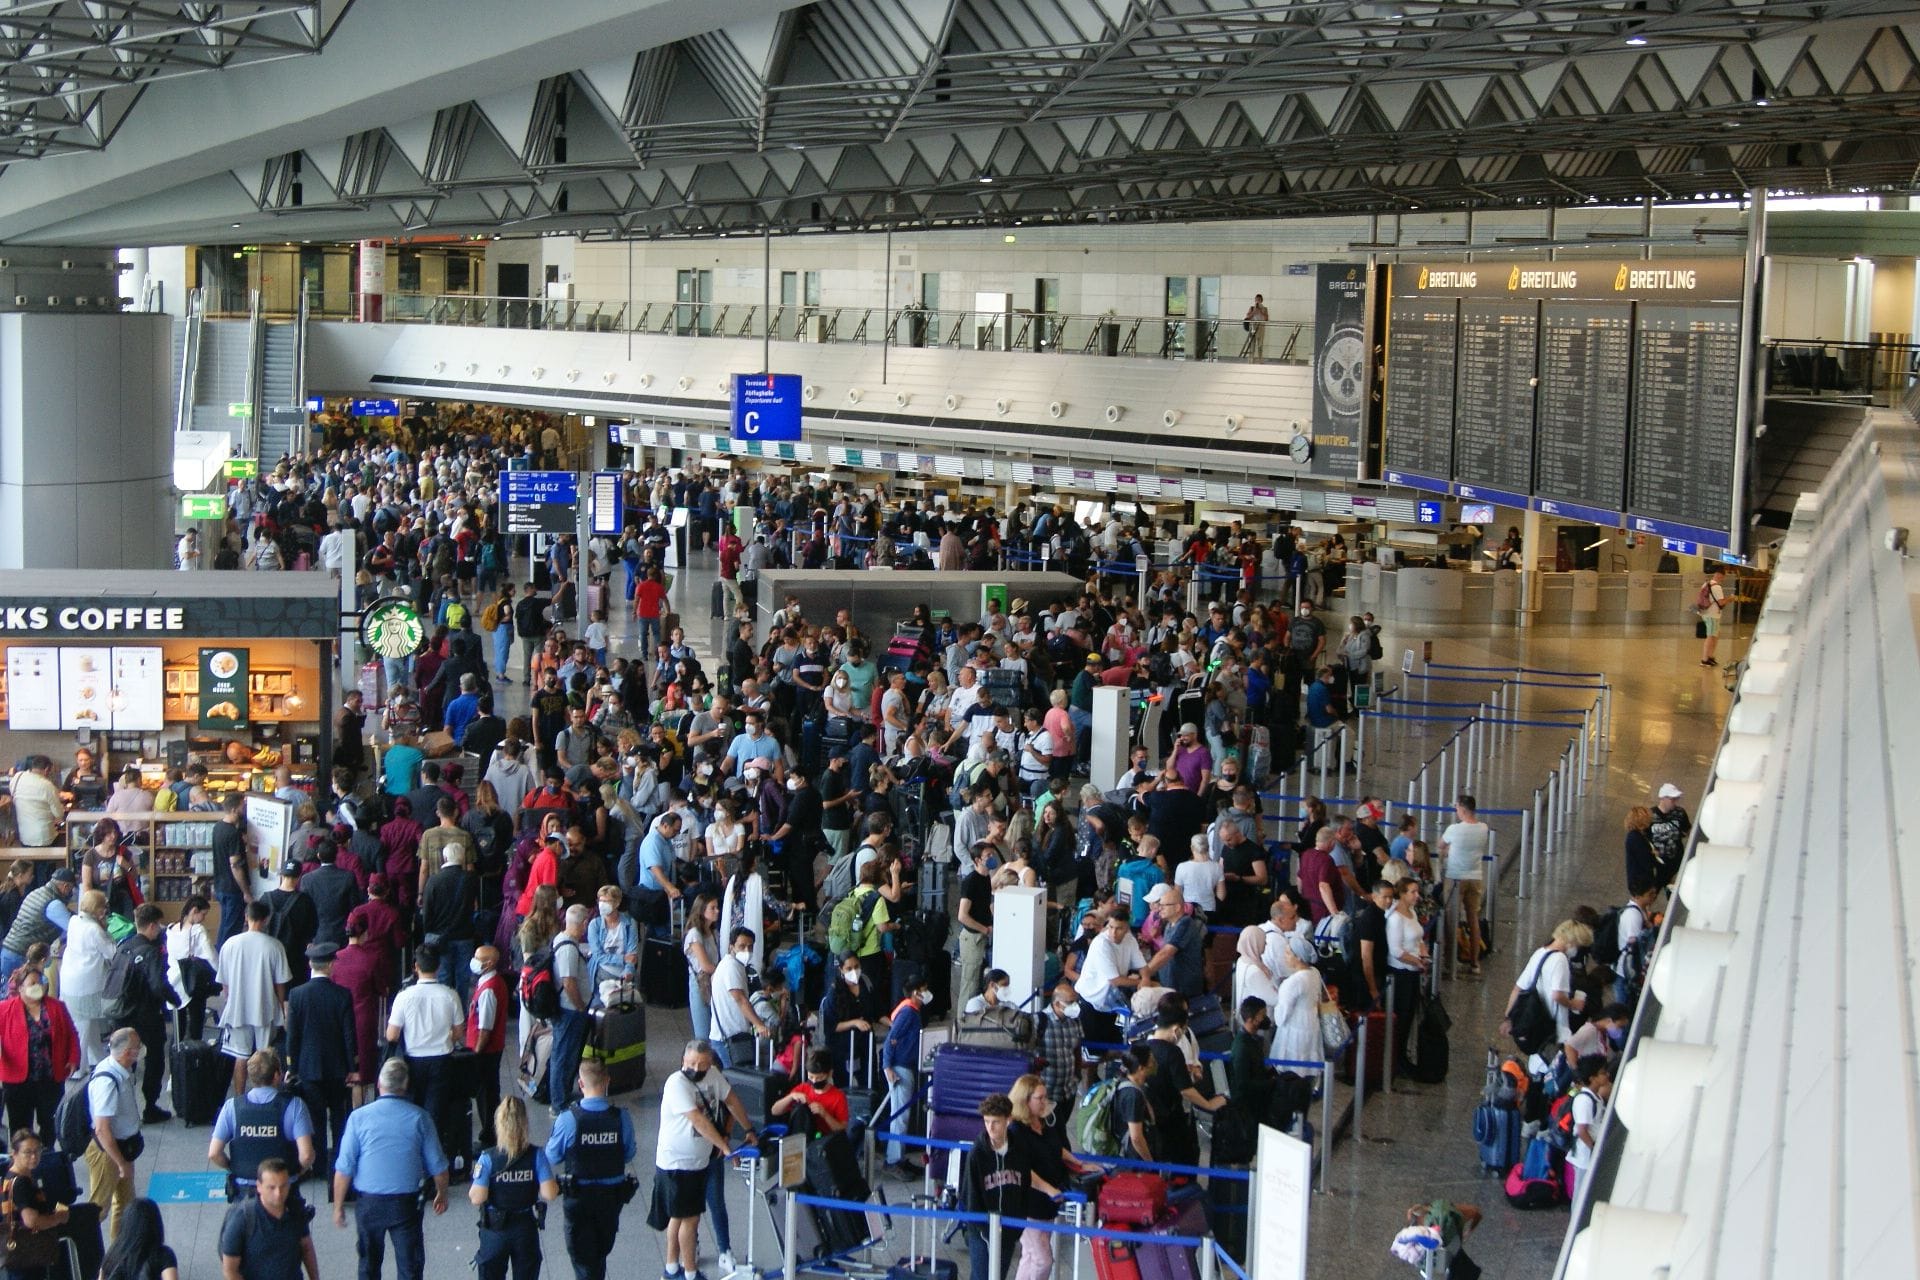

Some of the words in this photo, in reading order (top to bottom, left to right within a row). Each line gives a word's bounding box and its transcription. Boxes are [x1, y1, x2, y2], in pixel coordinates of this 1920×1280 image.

[1329, 281, 1366, 290] BREITLIN
[1429, 271, 1477, 288] BREITLING
[1521, 271, 1577, 289] BREITLING
[1630, 270, 1696, 290] BREITLING
[745, 411, 760, 434] C
[0, 606, 48, 630] KS
[59, 607, 184, 631] COFFEE
[240, 1125, 277, 1138] POLIZEI
[581, 1132, 618, 1145] POLIZEI
[496, 1169, 533, 1183] POLIZEI
